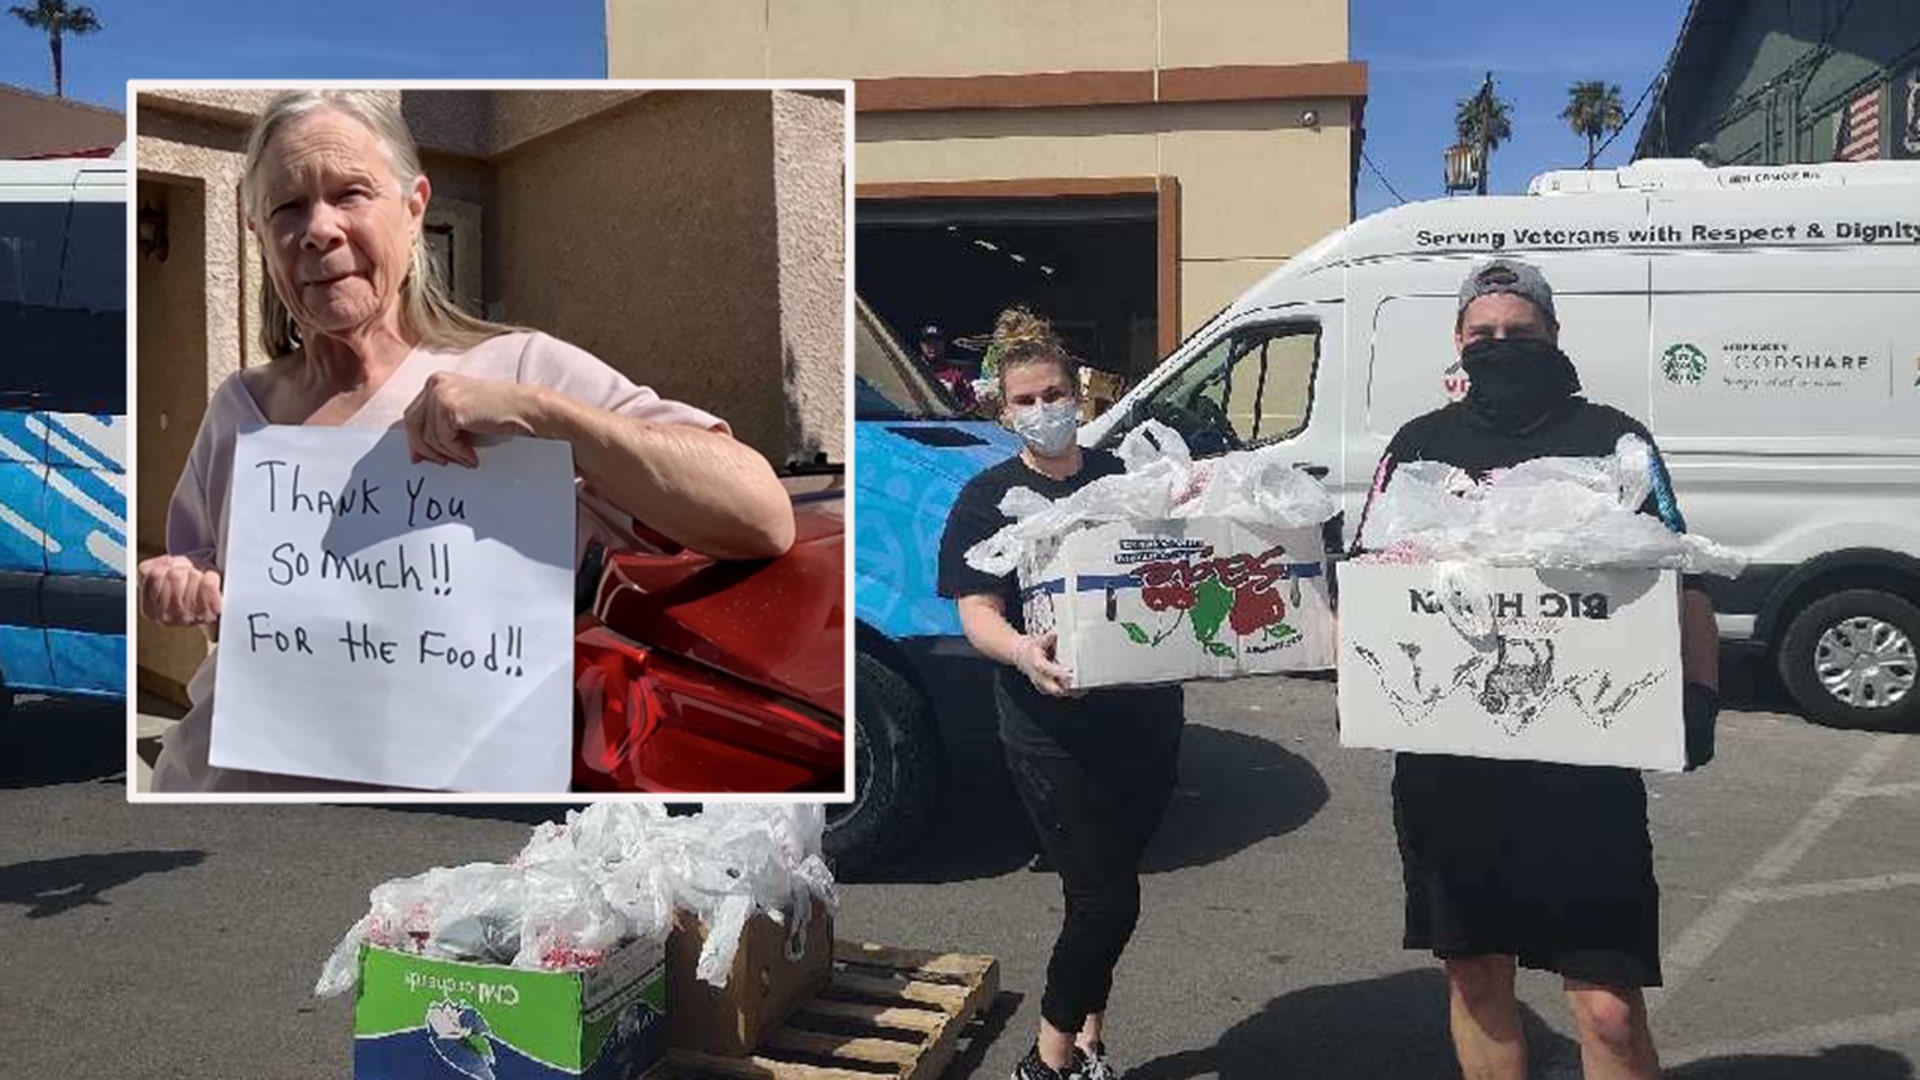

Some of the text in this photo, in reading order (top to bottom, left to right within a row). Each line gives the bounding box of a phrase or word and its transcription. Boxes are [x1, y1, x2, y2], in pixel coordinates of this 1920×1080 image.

[1416, 229, 1505, 249] Serving
[1513, 227, 1620, 246] Veterans
[1628, 224, 1682, 244] with
[1691, 223, 1796, 244] Respect
[1806, 222, 1825, 239] &
[1408, 587, 1609, 620] BIG HN
